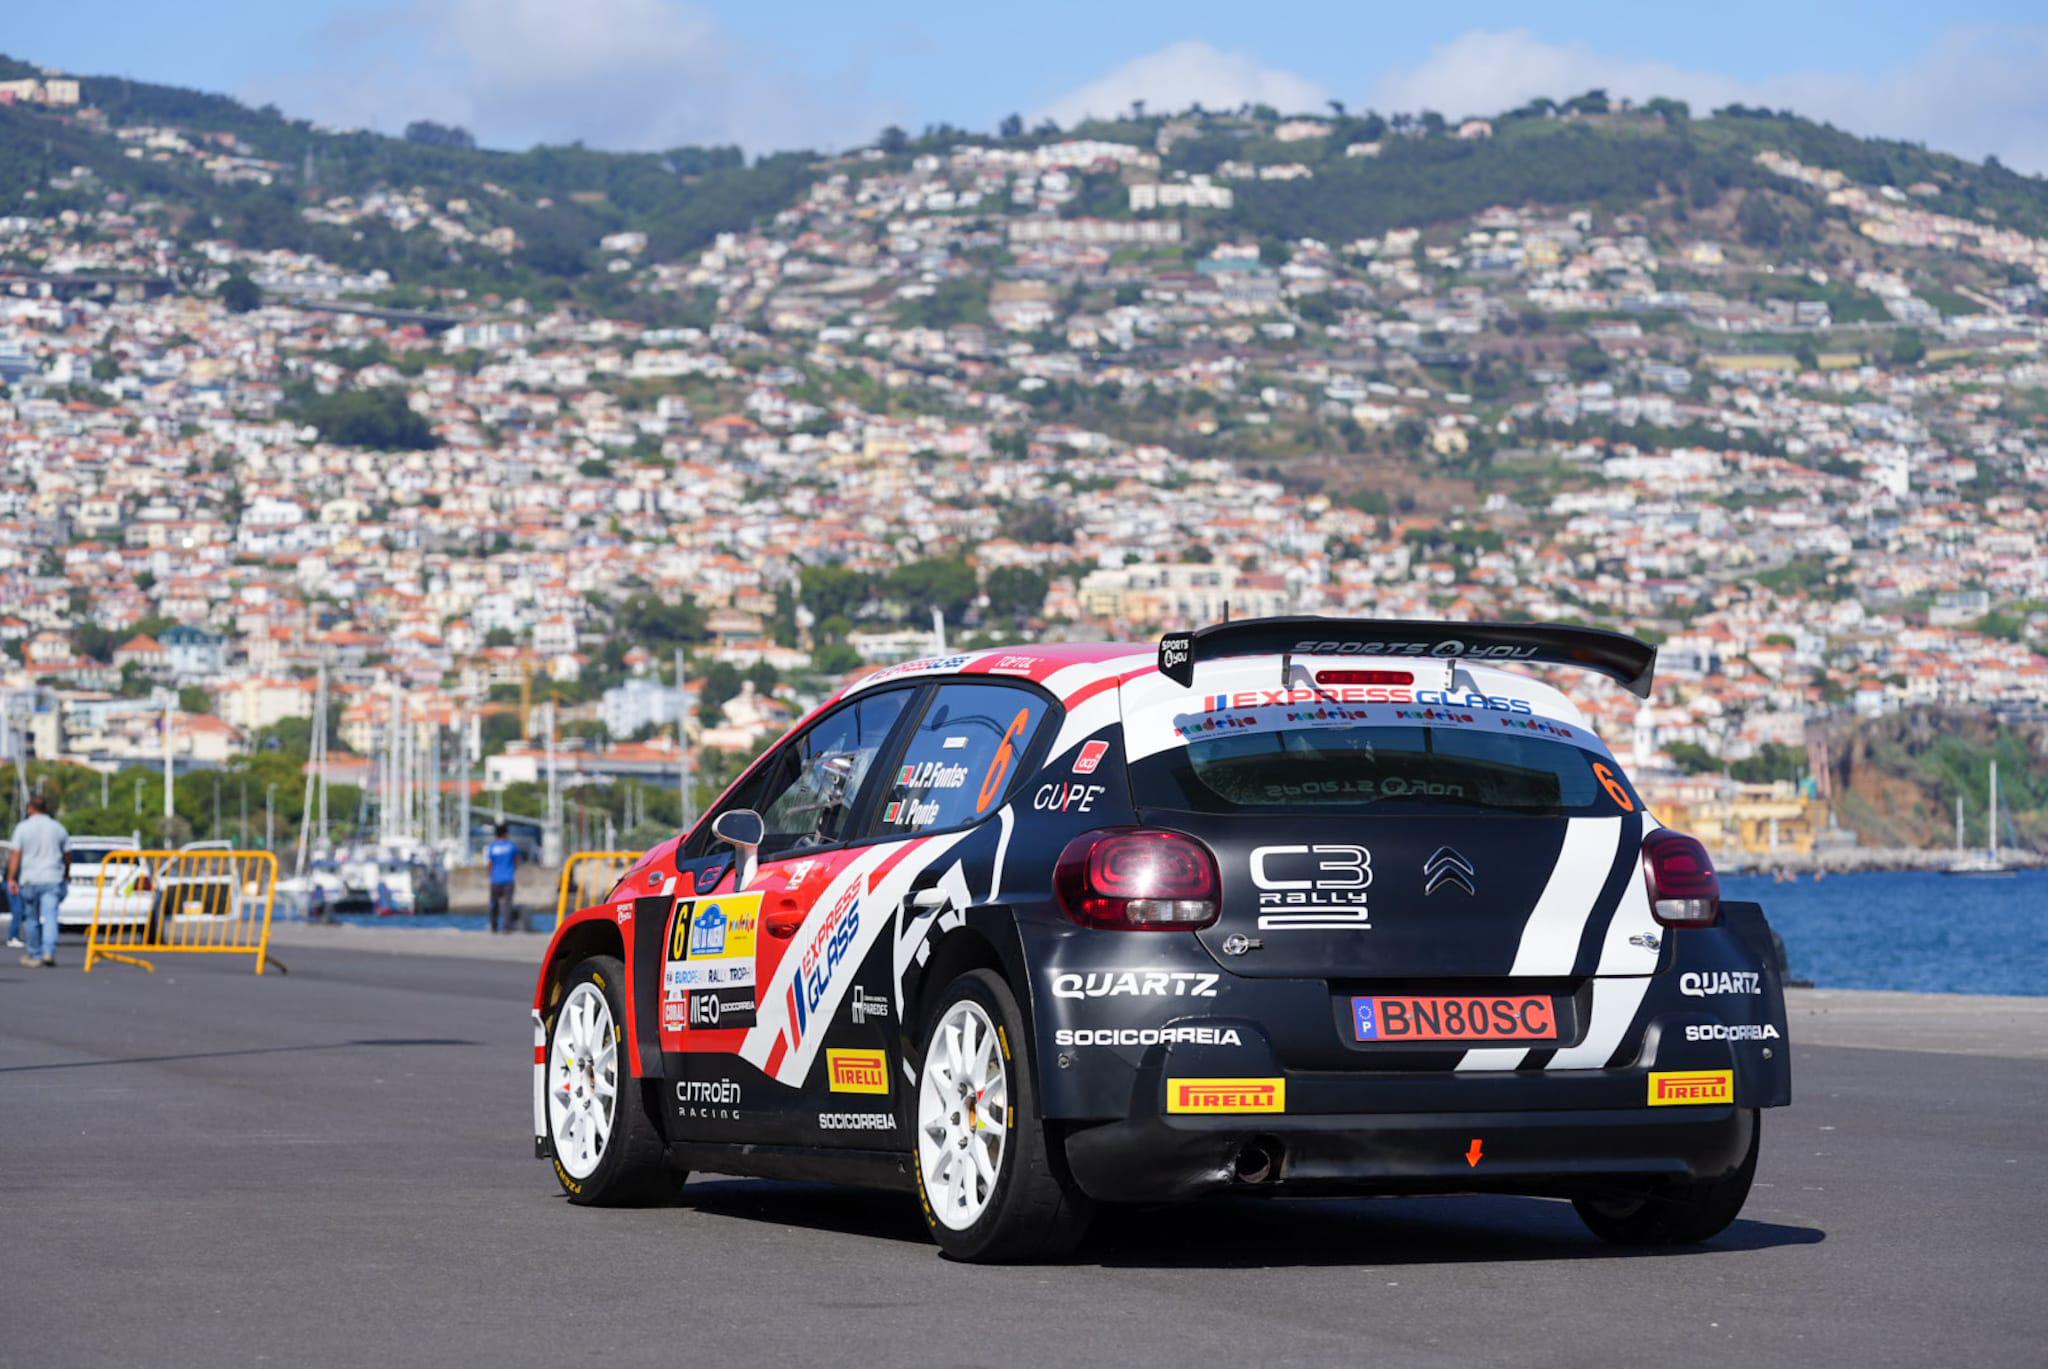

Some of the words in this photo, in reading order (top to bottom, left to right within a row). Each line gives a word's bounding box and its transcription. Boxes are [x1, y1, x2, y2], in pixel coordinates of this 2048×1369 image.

[1161, 640, 1189, 651] SPORTS
[1294, 641, 1431, 655] SPORTS
[1466, 646, 1539, 659] YOU
[1233, 689, 1412, 709] EXPRESS
[1416, 690, 1532, 715] GLASS
[977, 708, 1029, 813] 6
[1593, 763, 1634, 812] 6
[904, 799, 940, 825] Ponte
[1250, 845, 1373, 890] C3
[673, 903, 689, 960] 6
[802, 872, 864, 979] EXPRESS
[808, 899, 860, 1013] GLASS
[1052, 973, 1220, 1000] QUARTZ
[1680, 971, 1761, 997] QUARTZ
[1363, 1021, 1372, 1033] P
[1380, 1000, 1549, 1035] BN80SC
[1055, 1028, 1242, 1046] SOCICORREIA
[833, 1057, 883, 1085] PIRELLI
[1179, 1084, 1275, 1107] PIRELLI
[1657, 1077, 1727, 1099] PIRELLI
[818, 1113, 897, 1130] SOCICORREIA
